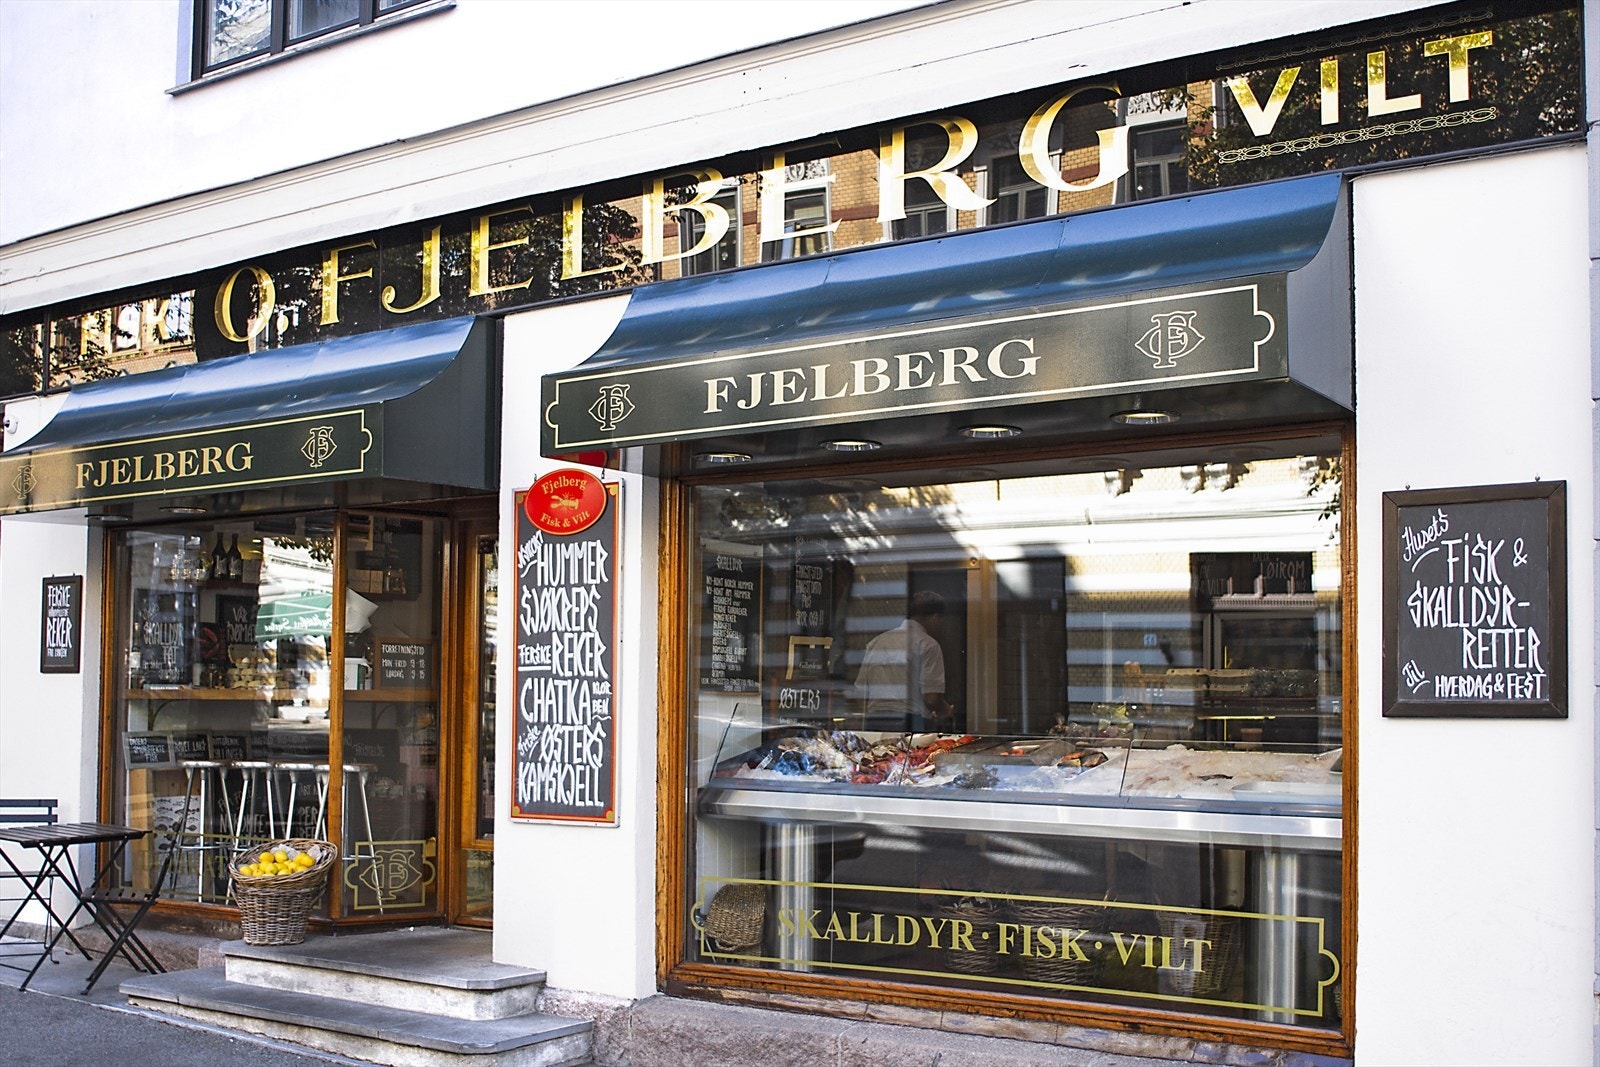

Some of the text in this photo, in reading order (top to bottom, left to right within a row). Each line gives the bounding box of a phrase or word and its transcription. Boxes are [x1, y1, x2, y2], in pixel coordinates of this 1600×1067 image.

[320, 83, 1131, 326] FJELBERG
[1228, 30, 1493, 137] VILT
[703, 337, 1042, 414] FJELBERG
[75, 441, 254, 489] FJELBERG
[541, 475, 588, 495] Fjelberg
[540, 510, 591, 528] Fisk & Vilt
[1402, 507, 1449, 562] Husets
[537, 539, 609, 587] HUMMER
[1512, 537, 1528, 567] &
[48, 584, 71, 607] FERSKE
[520, 585, 601, 636] SJØKREPS
[46, 617, 73, 649] REKER
[518, 631, 609, 679] FERSKE REKER
[1462, 626, 1545, 674] RETTER
[520, 677, 592, 726] CHATKA
[592, 698, 610, 715] BEN
[778, 687, 821, 714] ØSTERS
[1434, 673, 1493, 698] HVERDAG
[1506, 672, 1547, 699] FEST
[539, 721, 607, 769] ØSTERS
[518, 761, 605, 807] KAMSKJELL
